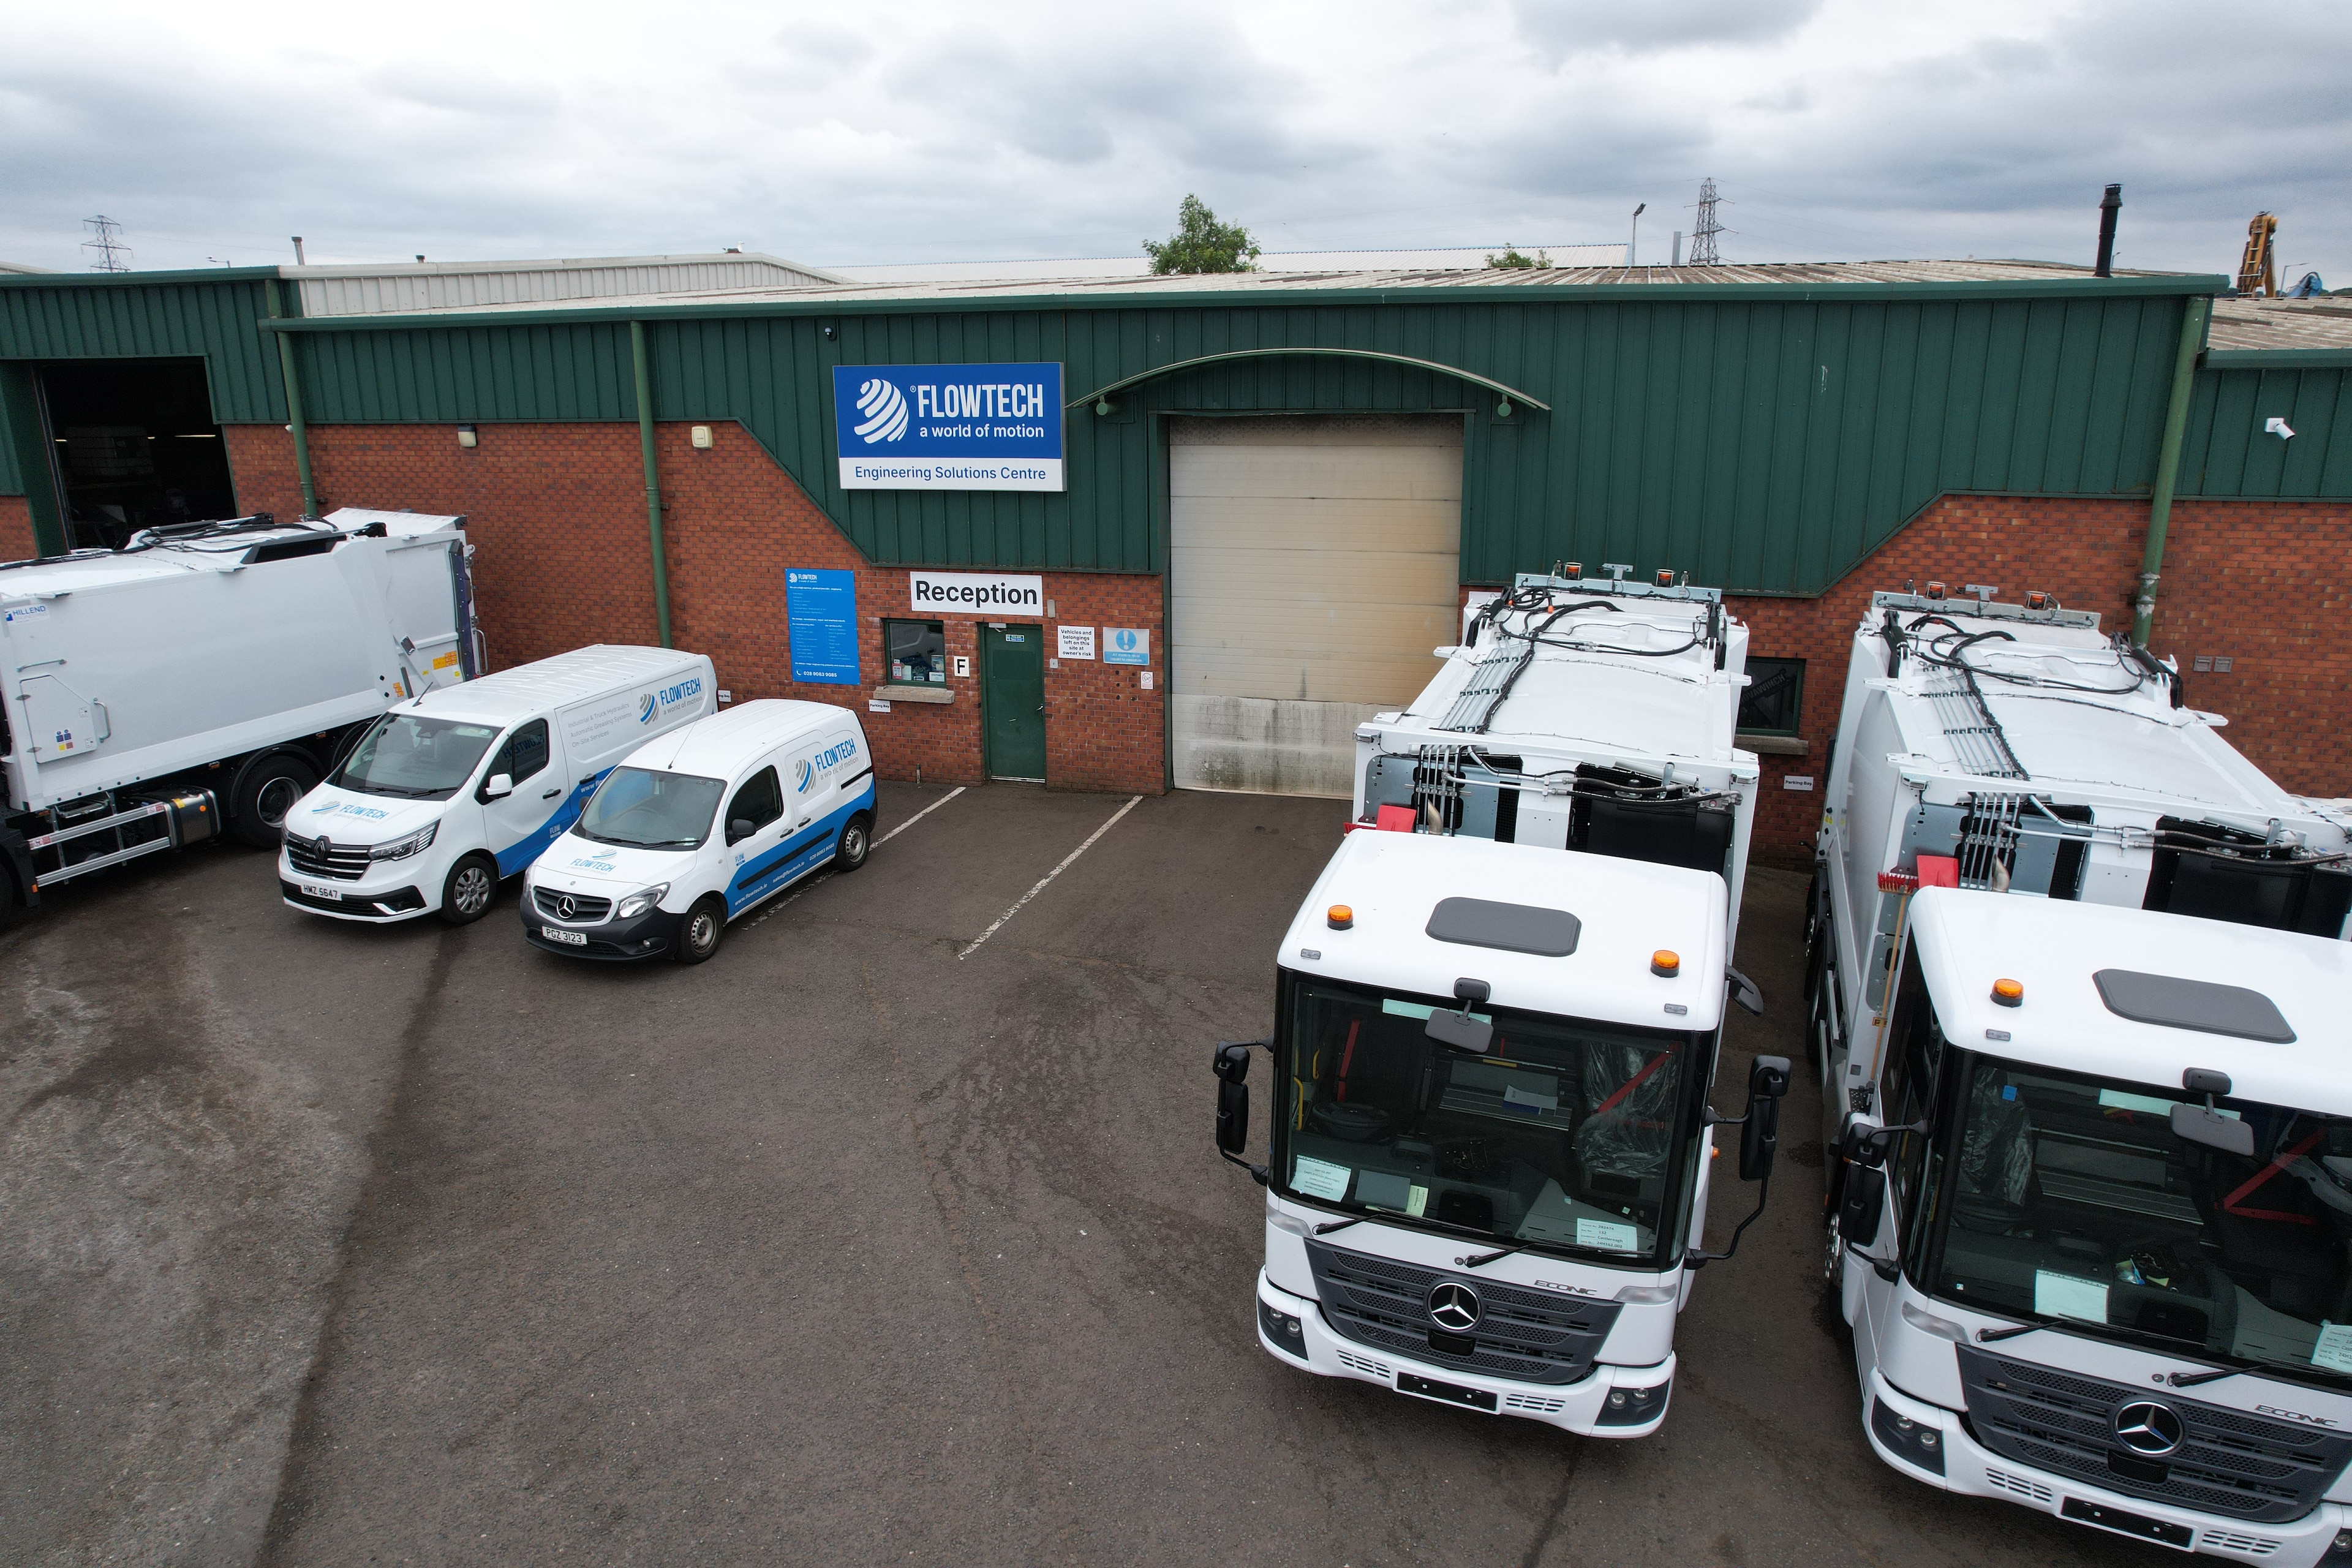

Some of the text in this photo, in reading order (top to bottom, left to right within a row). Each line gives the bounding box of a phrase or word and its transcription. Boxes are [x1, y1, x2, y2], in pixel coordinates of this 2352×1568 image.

[918, 383, 1044, 418] FLOWTECH
[919, 424, 1044, 438] a world of motion
[855, 466, 1047, 481] Engineering Solutions Centre
[916, 580, 1038, 608] Reception
[12, 605, 46, 616] HILLEND
[957, 659, 966, 674] F
[660, 677, 701, 706] FLOWTECH
[667, 704, 680, 714] world
[687, 696, 703, 706] motion
[568, 717, 589, 728] Industrial
[594, 710, 606, 719] Truck
[606, 703, 630, 715] Hydraulics
[570, 712, 632, 738] Automatic Greasing Systems
[572, 730, 609, 748] On-Site Services
[815, 738, 856, 772] FLOWTECH
[843, 756, 859, 767] motion
[339, 804, 390, 820] FLOWTECH
[549, 824, 560, 834] FLOW
[570, 859, 617, 872] FLOWTECH
[304, 884, 337, 898] HMZ 5647
[735, 883, 768, 906] www.flowtech.ie
[546, 929, 582, 943] PGZ 3123
[1534, 1280, 1597, 1295] ECONIC
[2255, 1404, 2338, 1427] ECONIC
